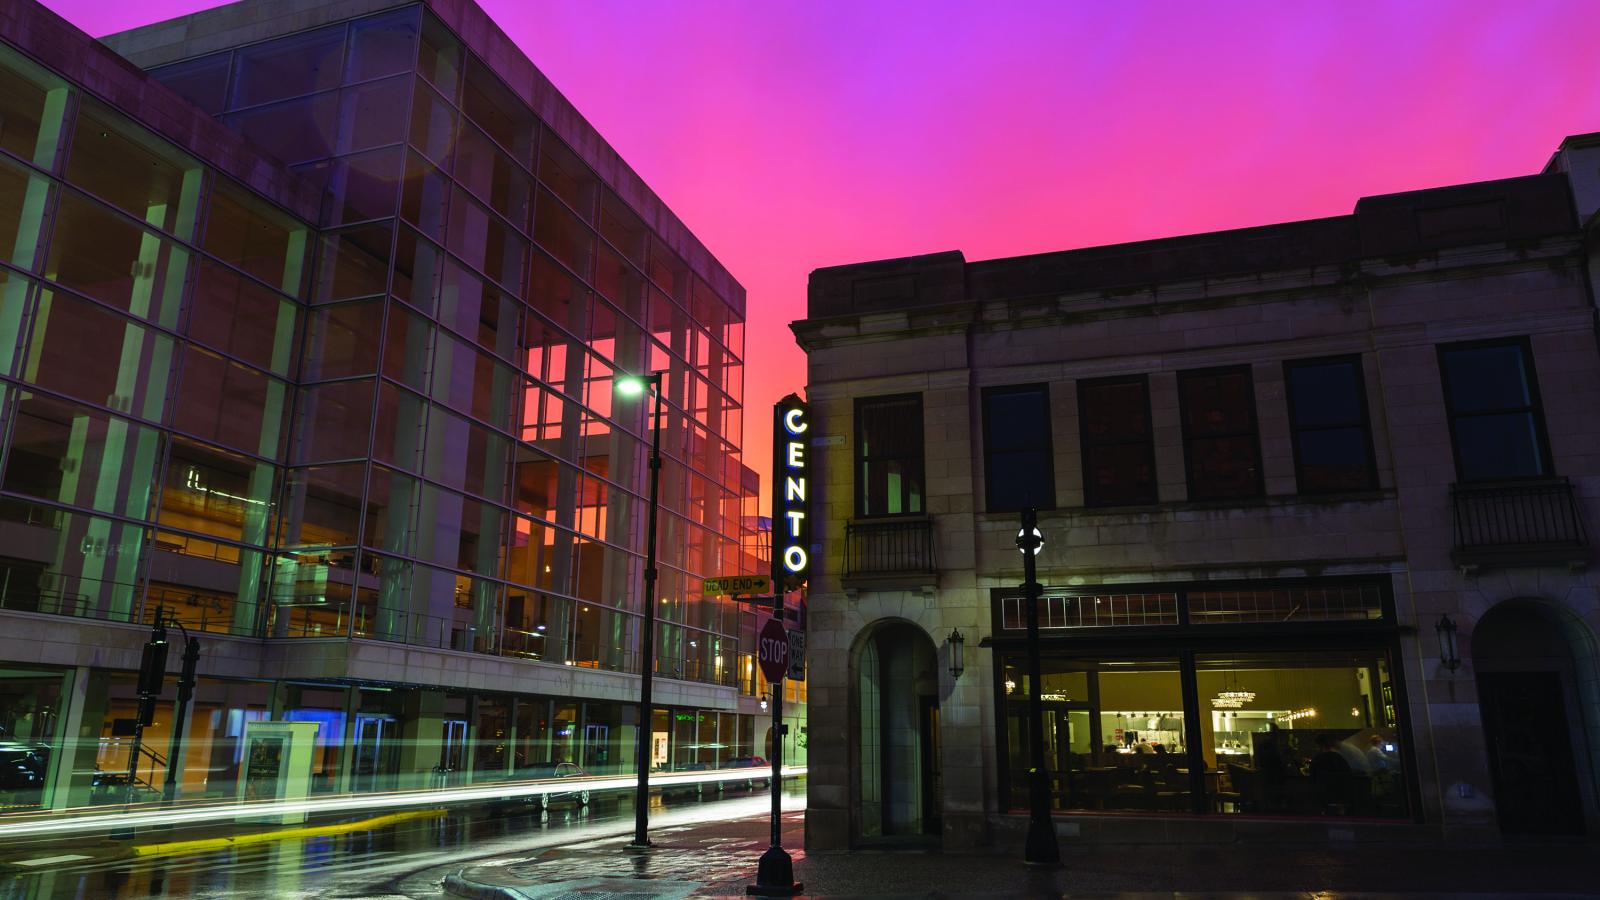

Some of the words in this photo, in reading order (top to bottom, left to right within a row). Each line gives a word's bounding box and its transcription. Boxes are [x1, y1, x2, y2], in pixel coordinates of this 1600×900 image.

[784, 408, 808, 572] CENTO
[705, 579, 729, 592] DEAD
[733, 578, 753, 591] END
[791, 635, 804, 649] ONE
[760, 637, 788, 665] STOP
[791, 648, 804, 662] WAY
